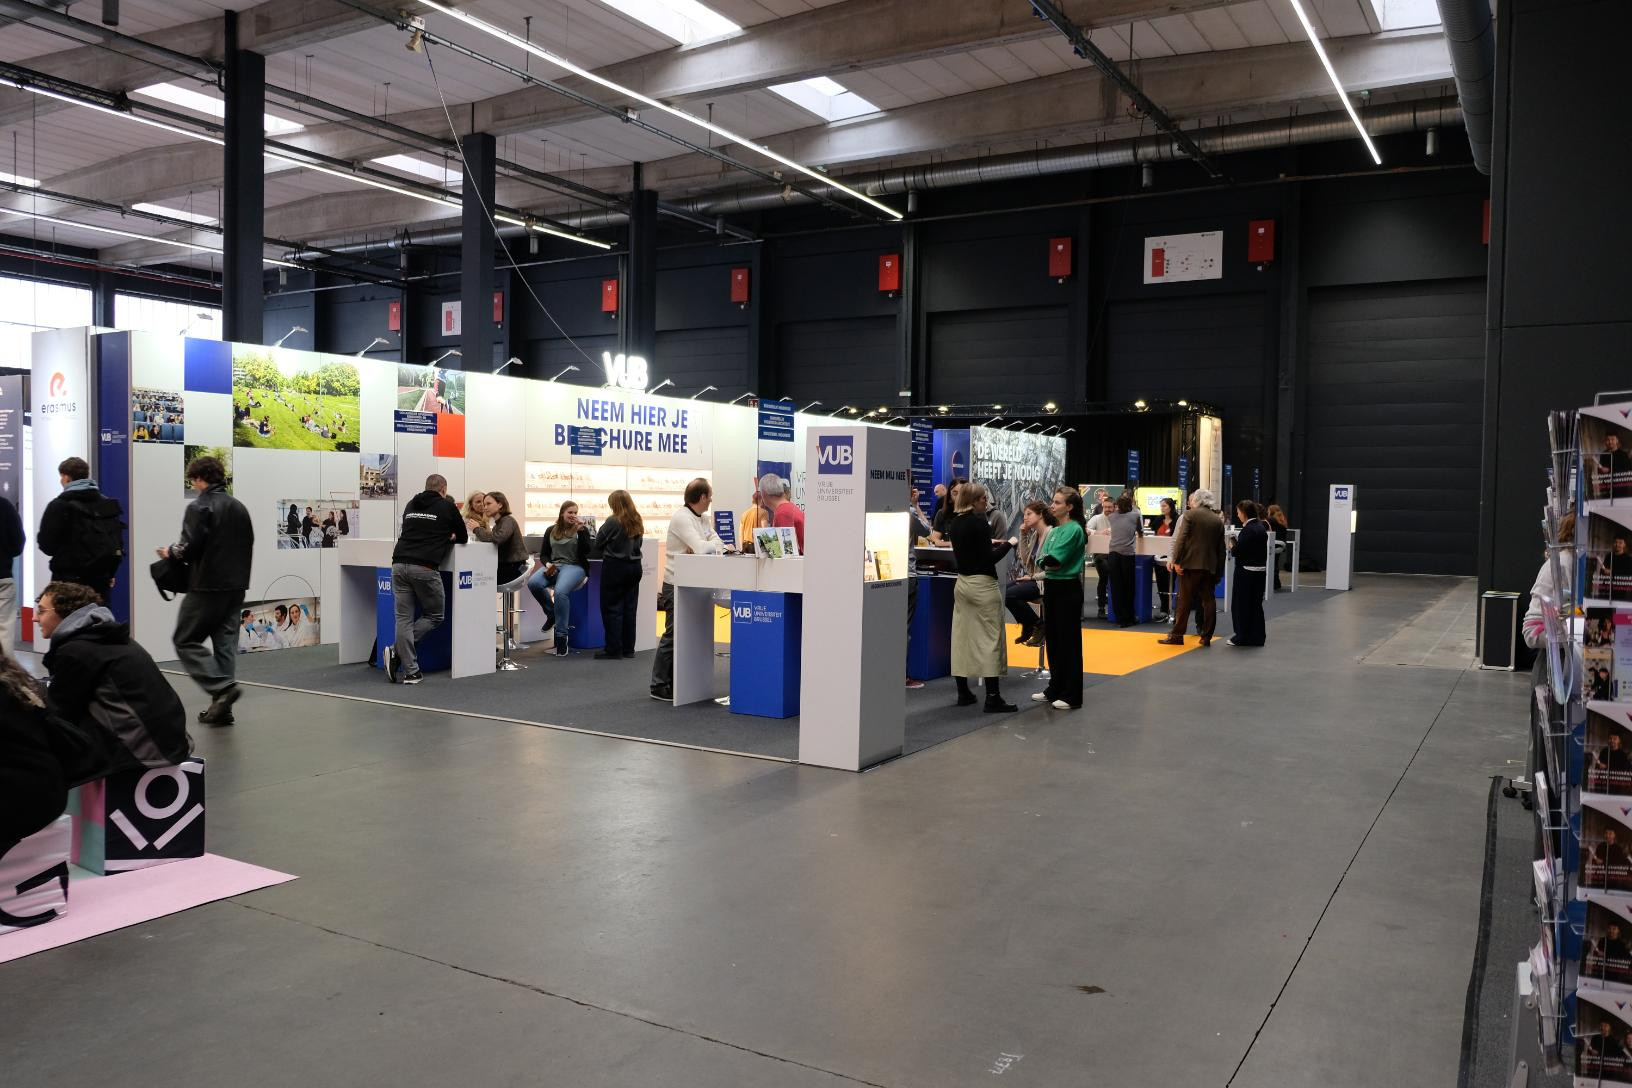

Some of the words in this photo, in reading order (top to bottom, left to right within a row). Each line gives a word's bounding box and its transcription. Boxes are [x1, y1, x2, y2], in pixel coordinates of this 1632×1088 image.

[602, 351, 648, 389] VUB
[41, 402, 76, 413] erasmus
[577, 397, 624, 423] NEEM
[631, 404, 667, 427] HIER
[671, 409, 688, 429] JE
[658, 432, 688, 454] MEE
[816, 445, 853, 465] VUB
[977, 442, 991, 460] DE
[991, 443, 1022, 462] WERELD
[870, 469, 884, 480] NEEM
[977, 461, 1001, 480] HEEFT
[1003, 463, 1014, 480] JE
[1014, 464, 1041, 481] NODIG
[1335, 490, 1348, 498] VUB
[377, 580, 391, 591] VUB
[459, 575, 472, 585] VUB
[733, 606, 751, 618] VUB
